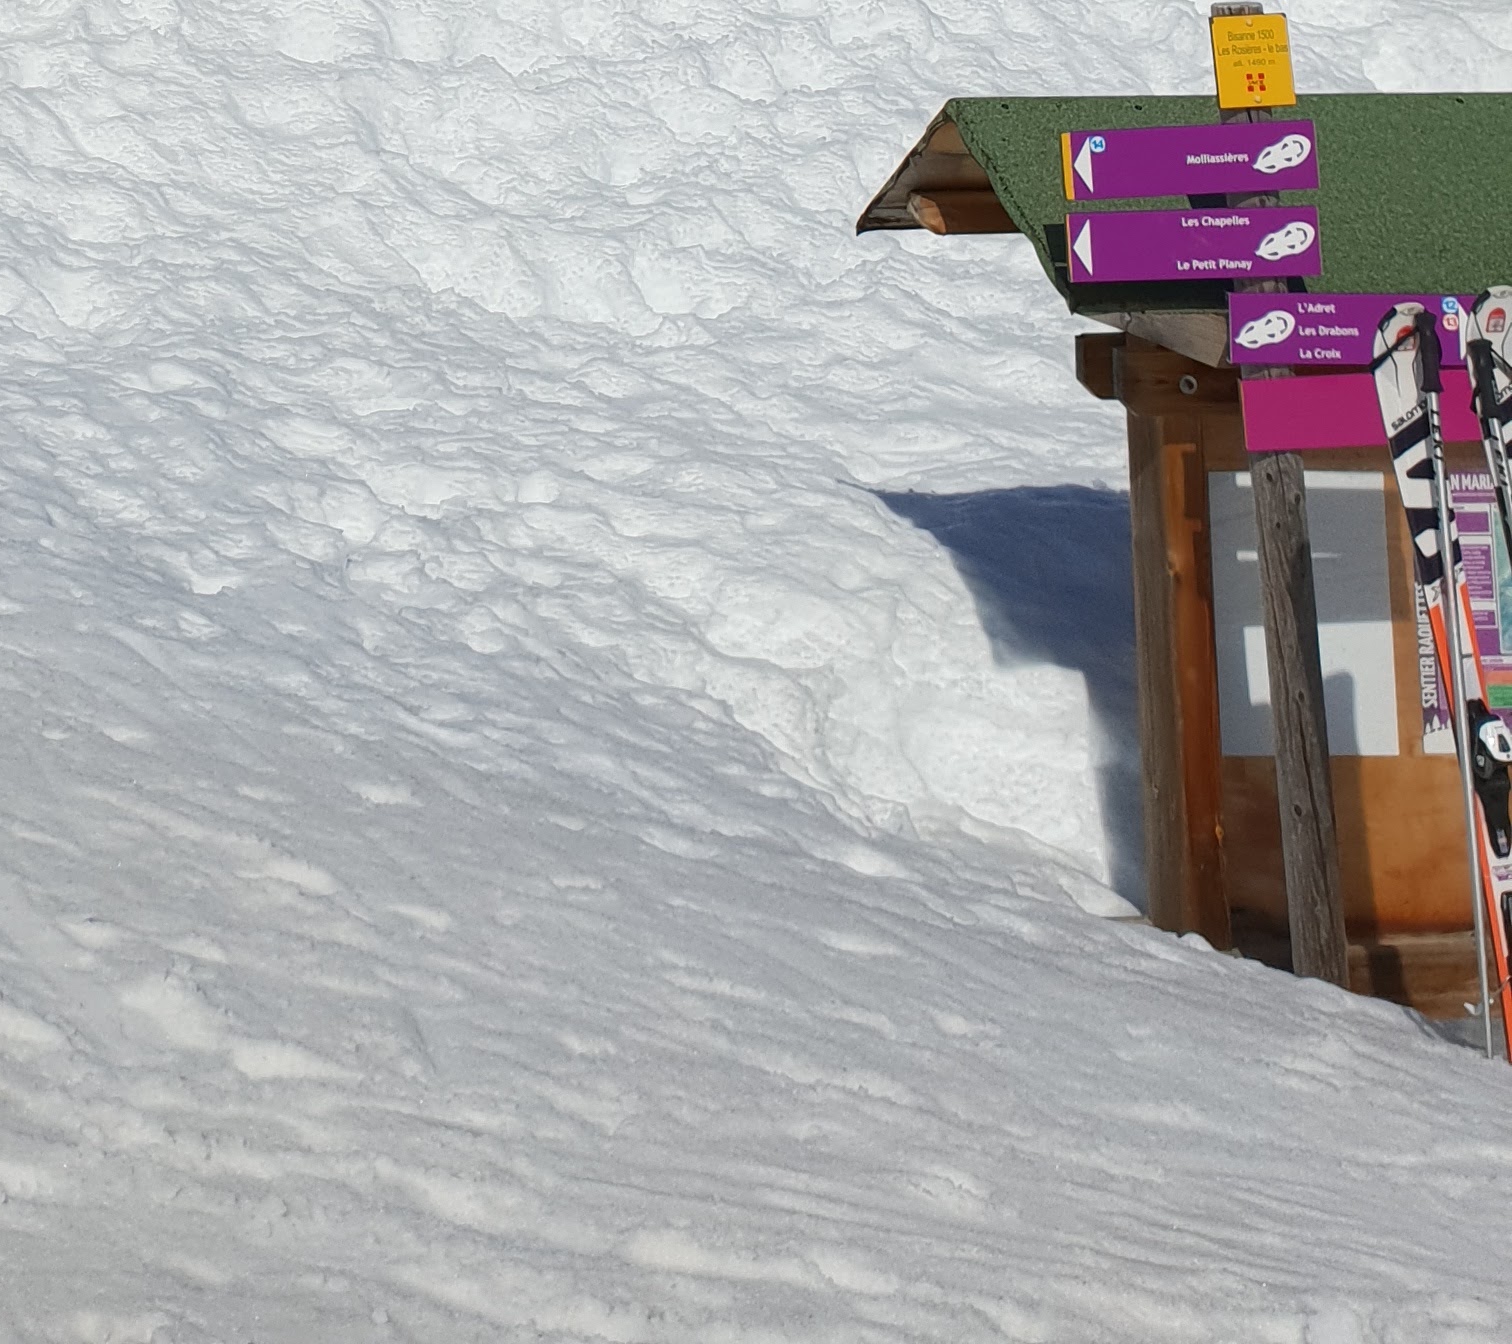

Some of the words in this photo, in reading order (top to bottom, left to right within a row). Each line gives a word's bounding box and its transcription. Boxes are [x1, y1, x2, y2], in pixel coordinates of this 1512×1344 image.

[1092, 139, 1104, 149] 14
[1182, 217, 1198, 226] Les
[1201, 215, 1249, 228] Chapelles
[1177, 261, 1190, 270] Le
[1192, 259, 1217, 270] Petit
[1219, 259, 1252, 271] Planay
[1297, 302, 1336, 314] L'Adret
[1298, 325, 1317, 336] Les
[1318, 325, 1359, 336] Drabons
[1299, 348, 1313, 359] La
[1314, 348, 1342, 359] Croix
[1419, 656, 1438, 708] SENTIER
